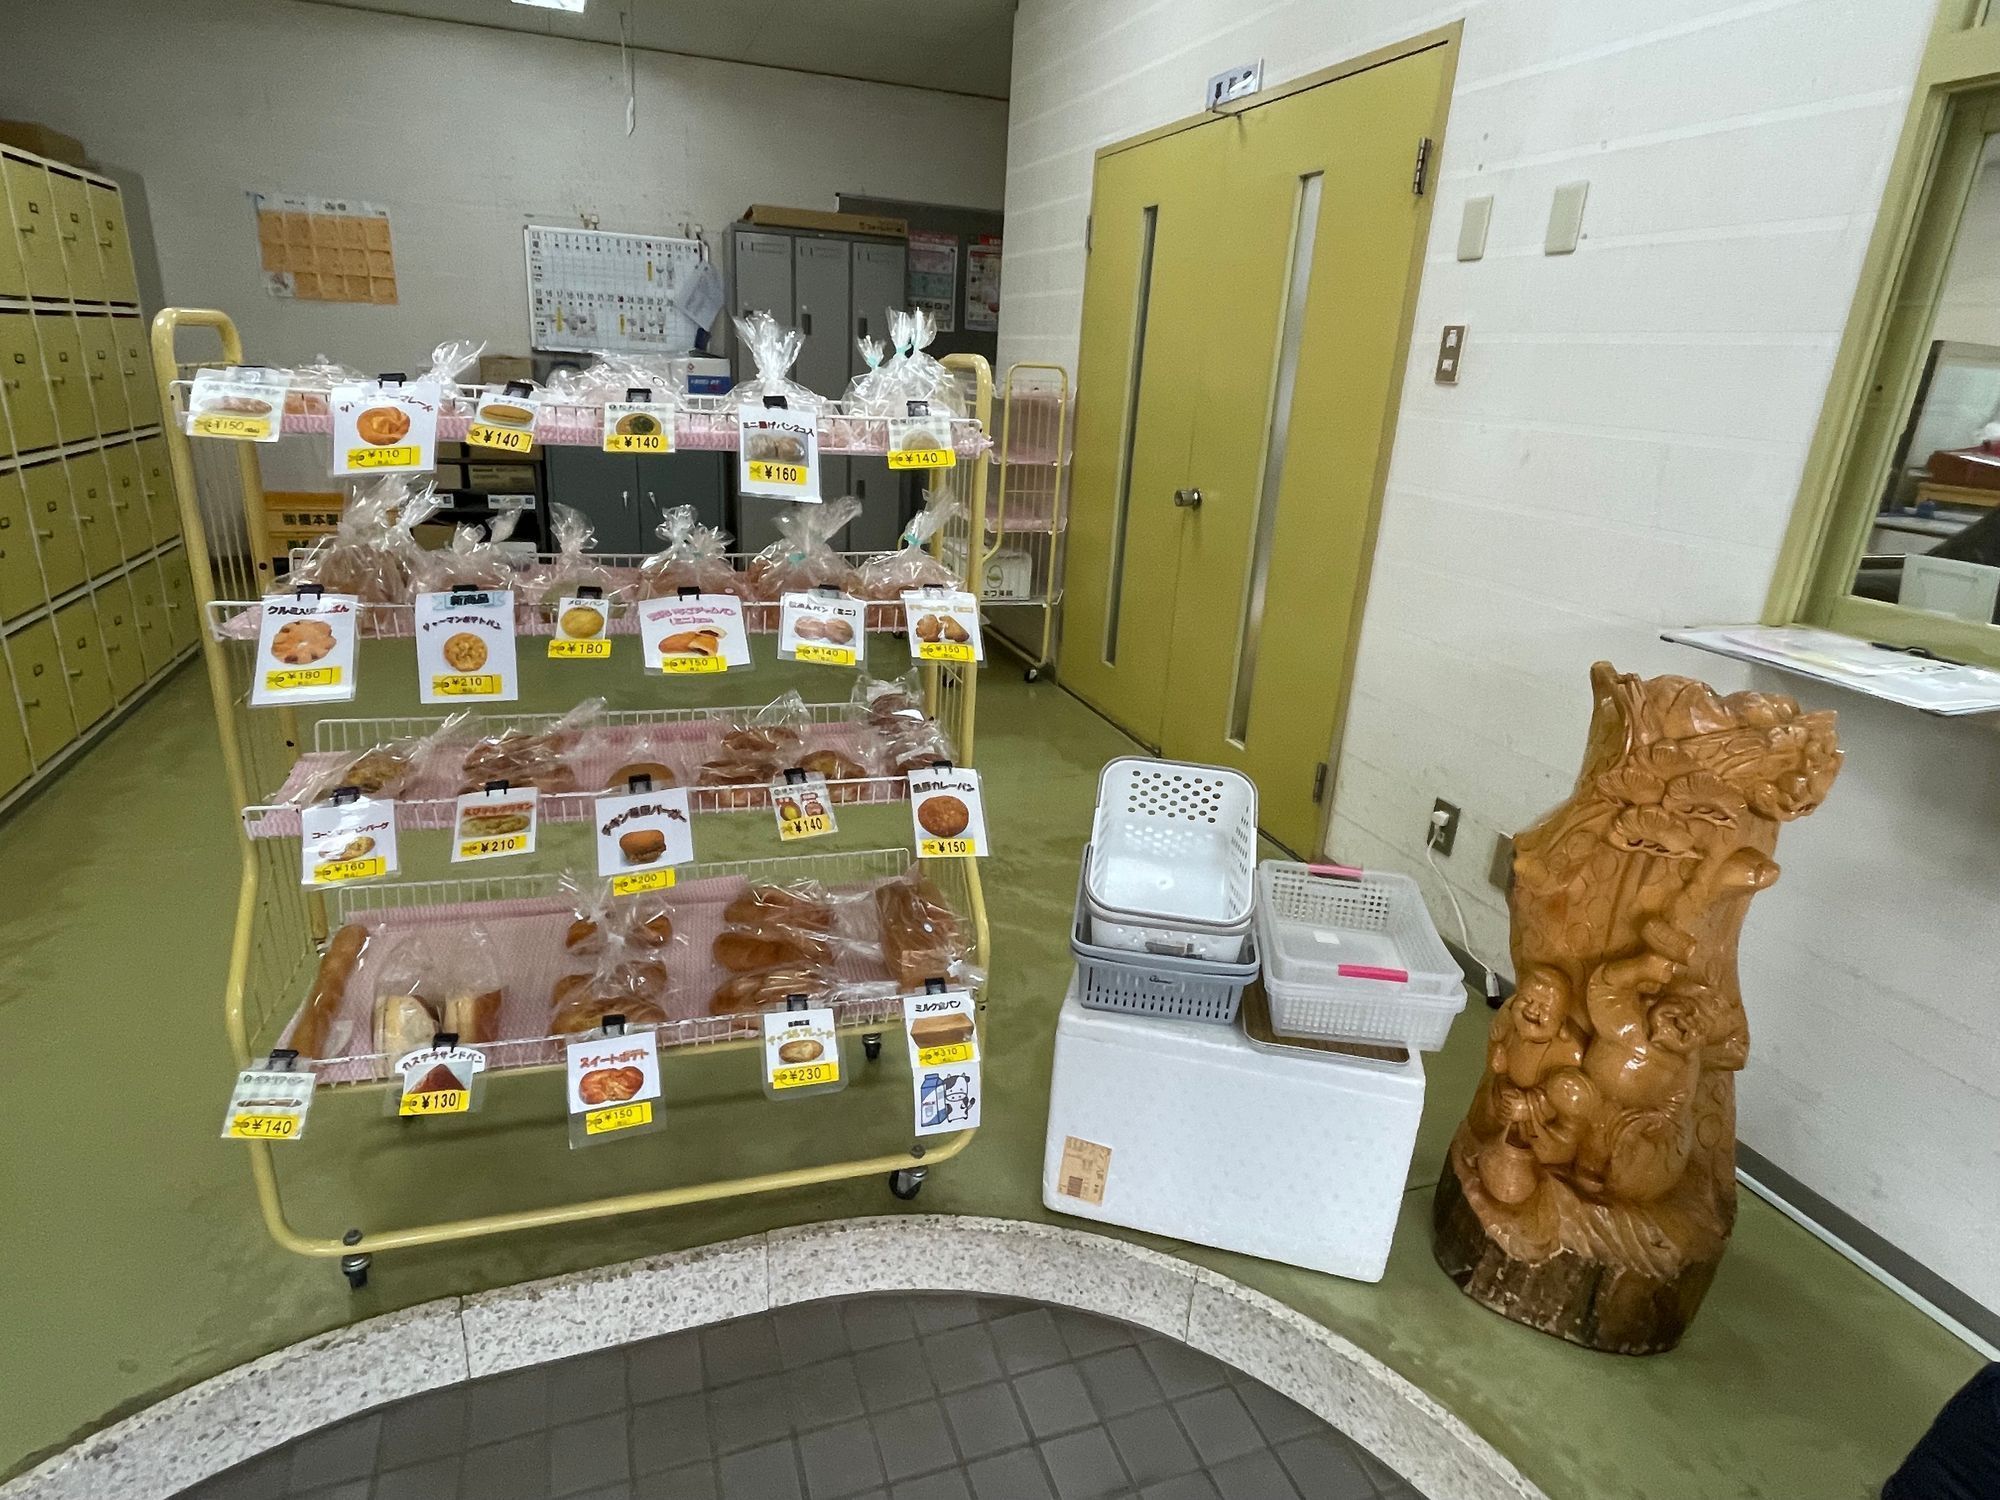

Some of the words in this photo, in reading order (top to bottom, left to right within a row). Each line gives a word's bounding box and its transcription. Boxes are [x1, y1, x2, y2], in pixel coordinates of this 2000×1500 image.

[483, 429, 519, 447] ¥140
[624, 436, 659, 449] ¥140
[905, 452, 938, 464] ¥140
[764, 465, 798, 482] ¥160
[567, 643, 603, 654] ¥180
[812, 647, 839, 657] ¥140
[287, 671, 321, 680] ¥180
[451, 677, 483, 687] ¥210
[793, 817, 823, 834] ¥140
[480, 839, 515, 853] ¥210
[937, 841, 967, 853] ¥150
[334, 862, 365, 872] ¥160
[789, 1067, 821, 1082] ¥230
[421, 1092, 457, 1109] ¥130
[604, 1108, 633, 1120] ¥150
[252, 1119, 292, 1134] ¥140
